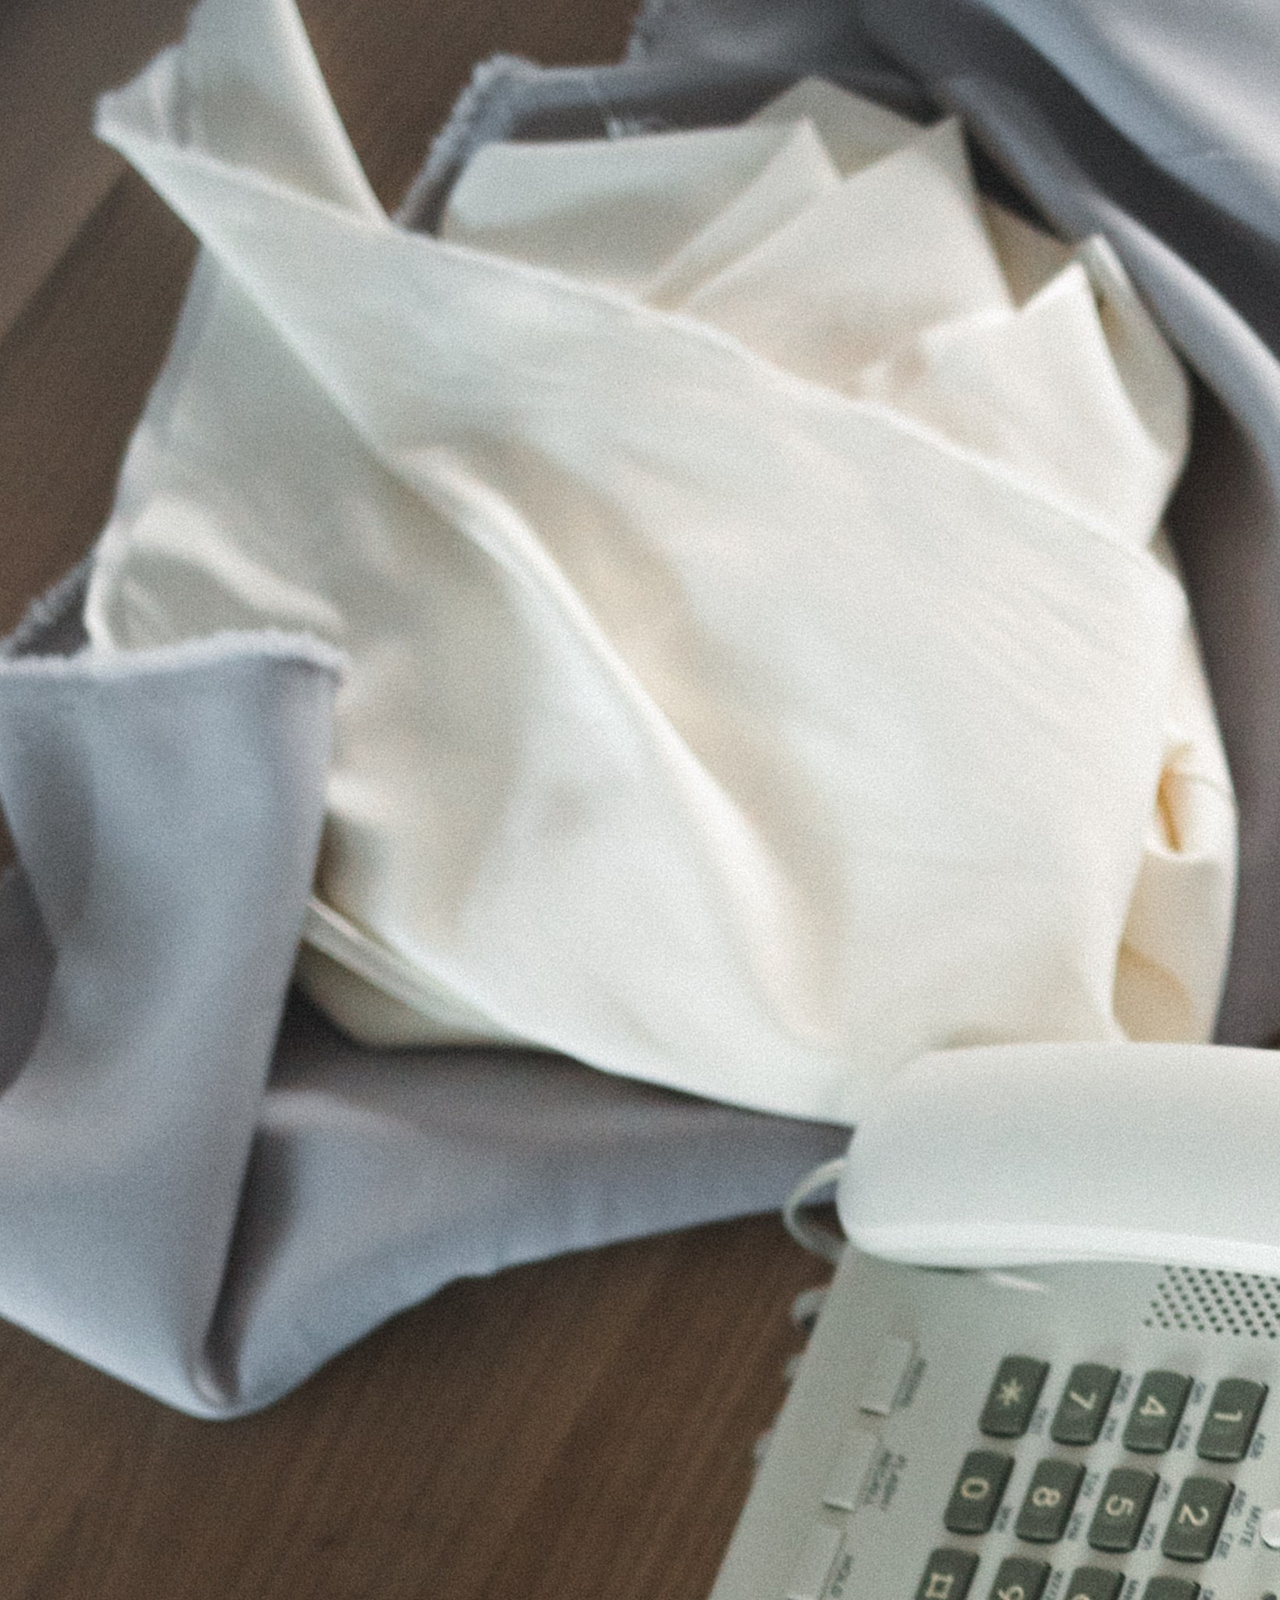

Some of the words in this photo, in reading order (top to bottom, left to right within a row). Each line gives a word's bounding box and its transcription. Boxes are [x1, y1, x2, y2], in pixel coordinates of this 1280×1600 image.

[1066, 1386, 1096, 1411] 7
[1137, 1393, 1169, 1421] 4
[1211, 1404, 1243, 1426] 1
[957, 1473, 990, 1503] 0
[1030, 1484, 1062, 1511] 8
[1103, 1492, 1135, 1520] 5
[1176, 1500, 1211, 1531] 2
[1237, 1504, 1261, 1548] MUTE
